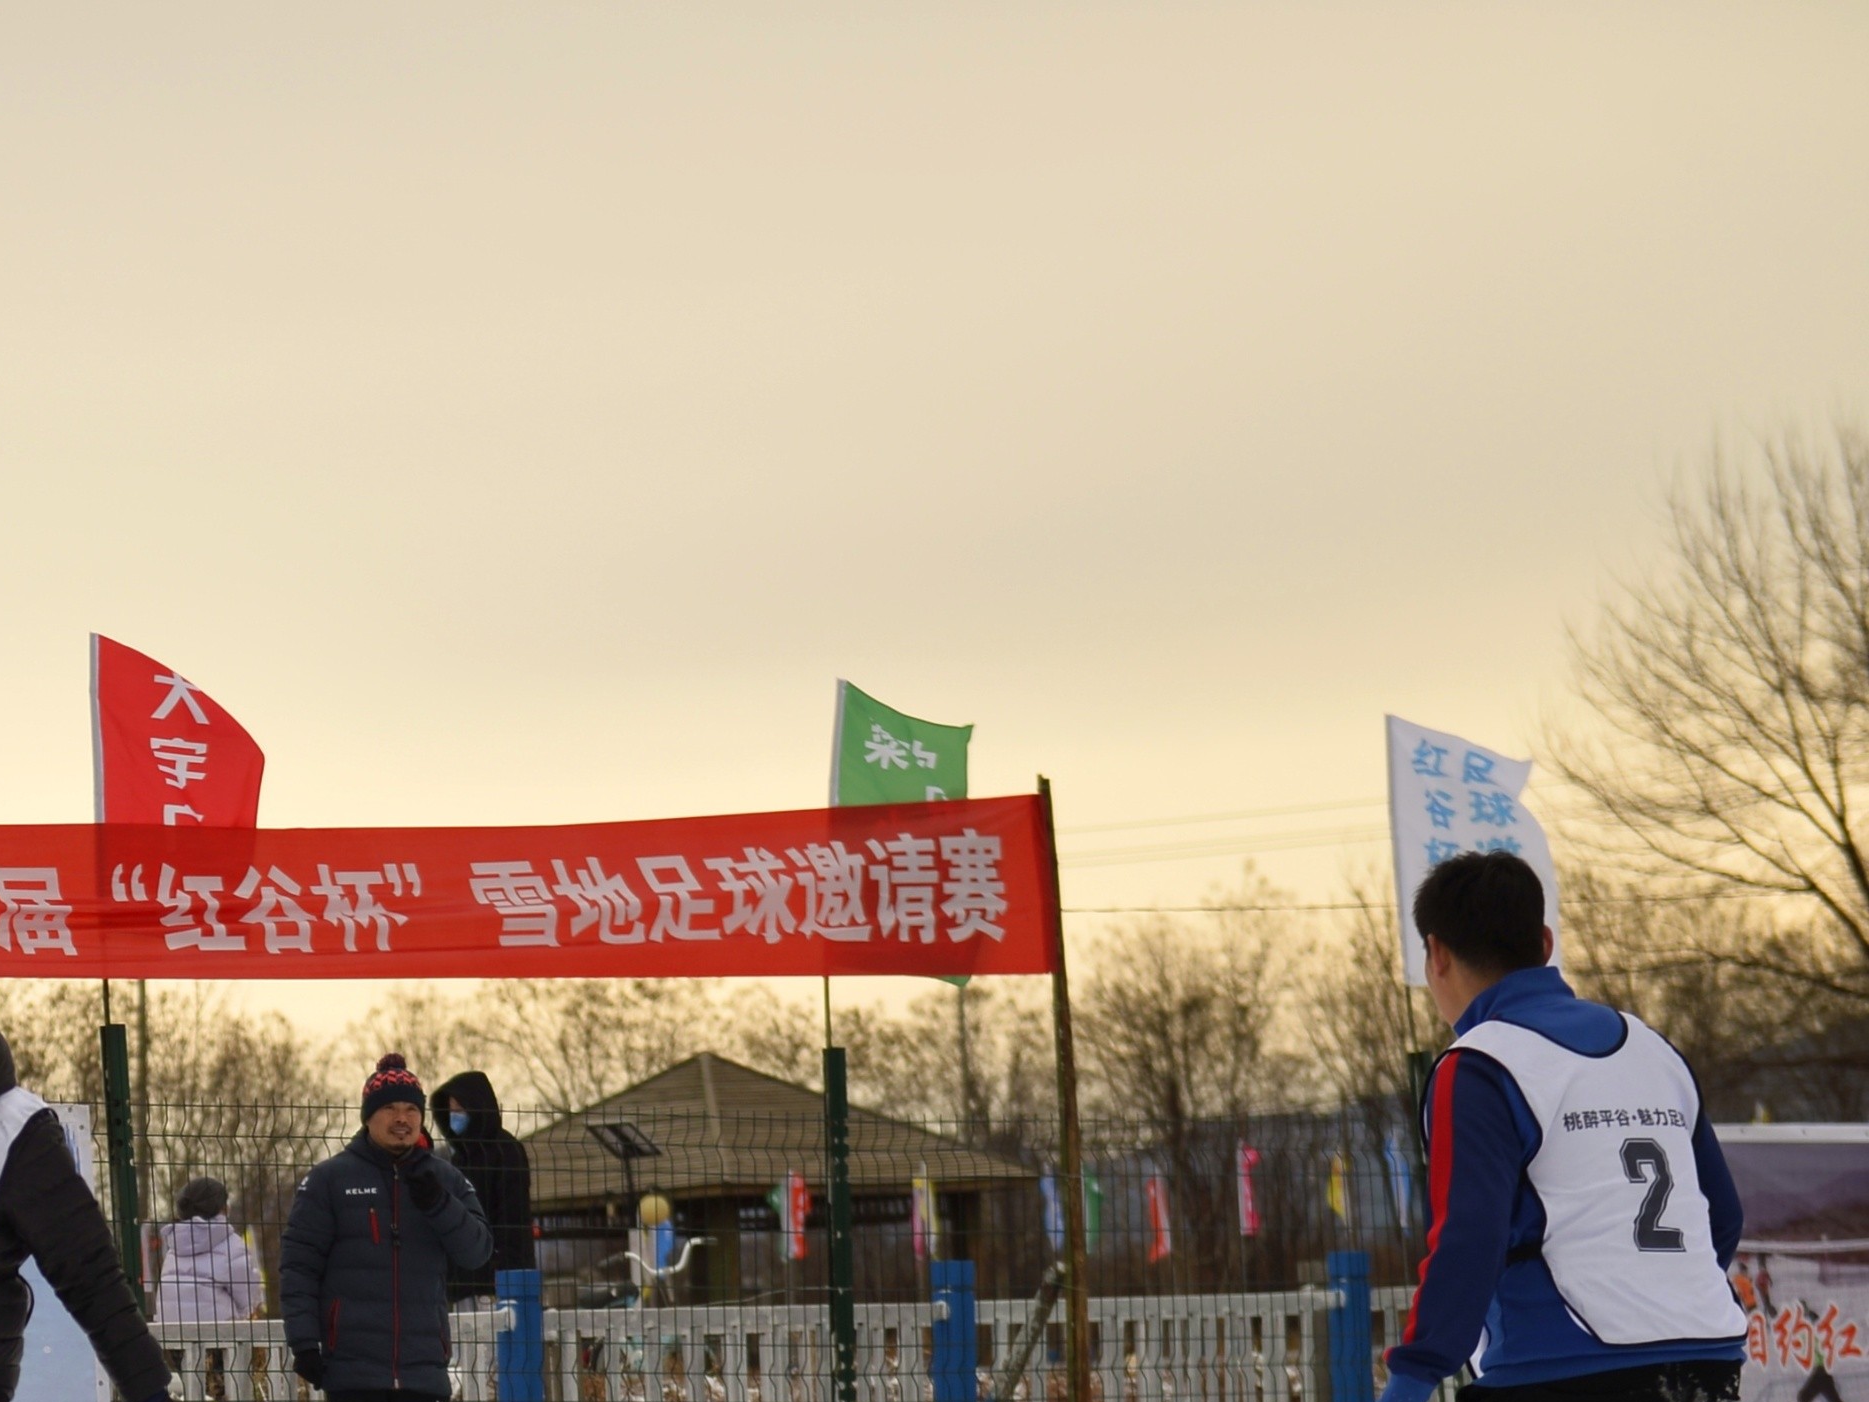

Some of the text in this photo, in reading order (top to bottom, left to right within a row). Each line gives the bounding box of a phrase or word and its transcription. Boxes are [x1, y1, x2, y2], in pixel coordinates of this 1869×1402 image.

[468, 827, 1009, 949] 雪地足球邀请赛
[345, 1186, 378, 1195] KELME
[1618, 1137, 1687, 1252] 2
